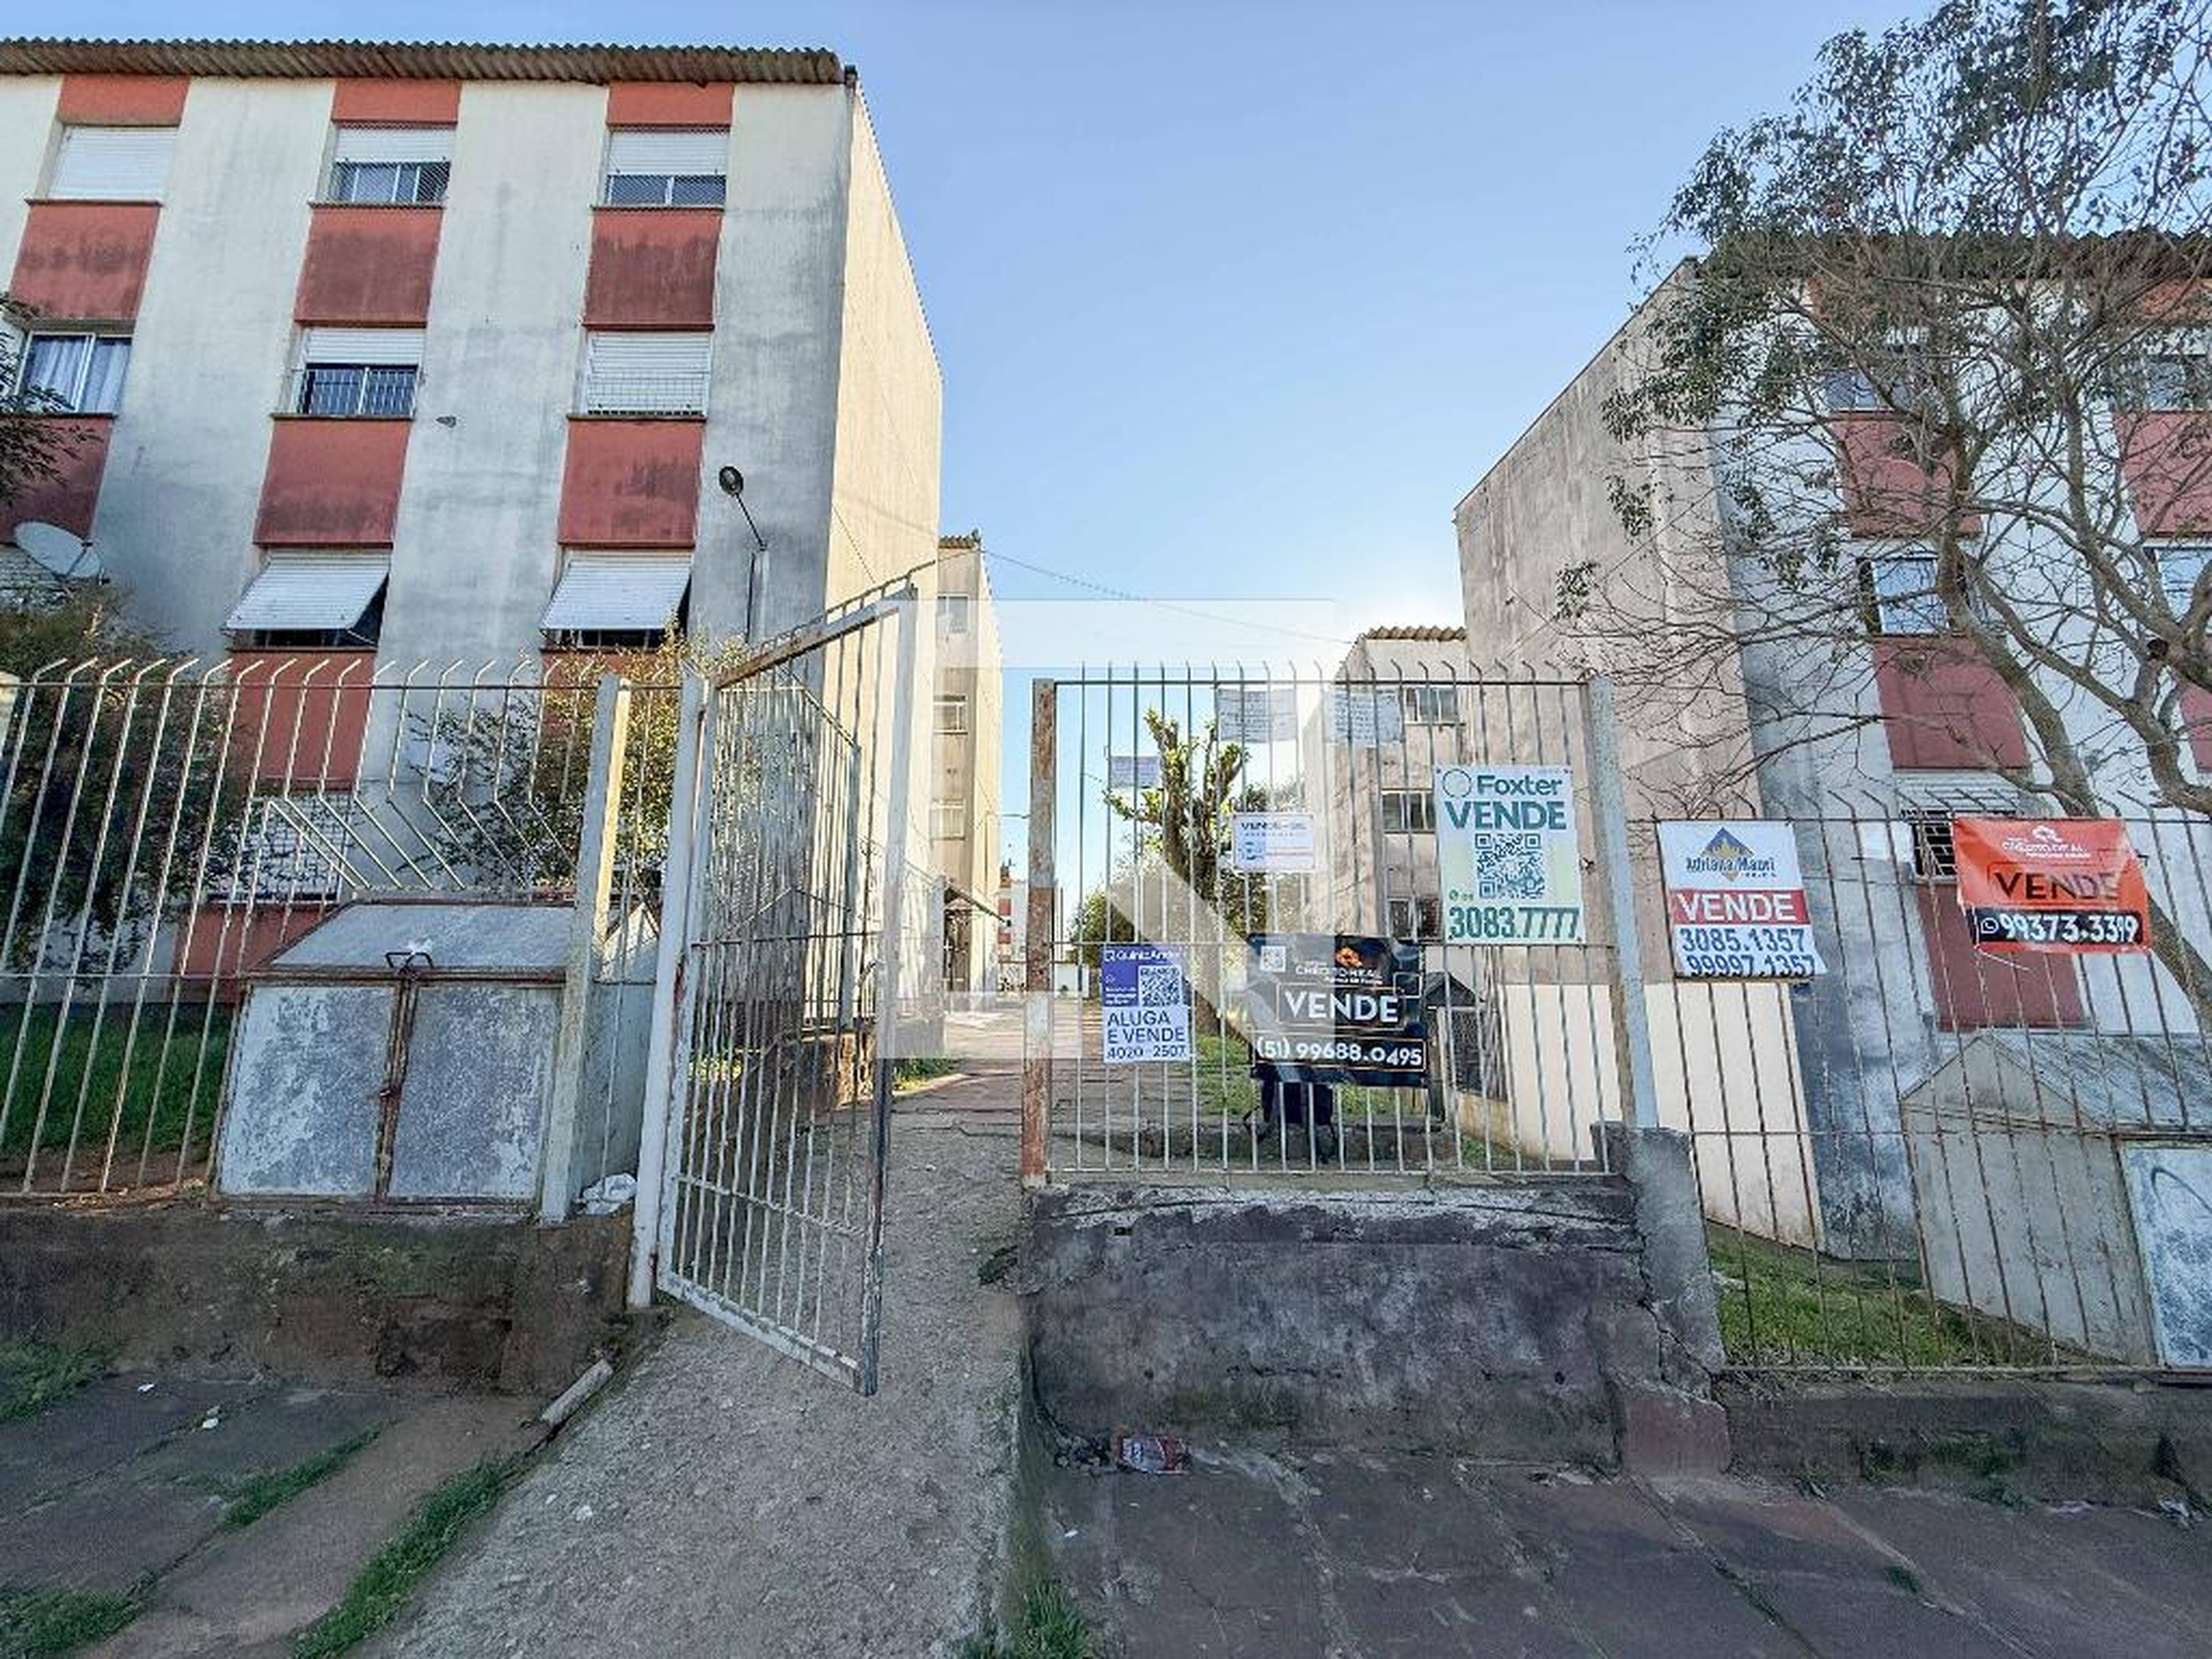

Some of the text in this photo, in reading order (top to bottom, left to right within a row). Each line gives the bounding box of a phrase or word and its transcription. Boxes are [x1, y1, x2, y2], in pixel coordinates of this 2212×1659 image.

[1477, 775, 1562, 795] Foxter
[1445, 801, 1567, 830] VENDE
[1994, 871, 2122, 900] VENDE
[1676, 893, 1797, 922] VENDE
[1449, 906, 1580, 939] 3083.7777
[1679, 927, 1805, 953] 3085.1357
[1686, 955, 1816, 978] 99997.1357
[1107, 1010, 1171, 1027] ALUGA
[1285, 991, 1399, 1023] VENDE
[1108, 1028, 1185, 1044] E VENDE
[1256, 1036, 1423, 1066] (51) 99688.0495
